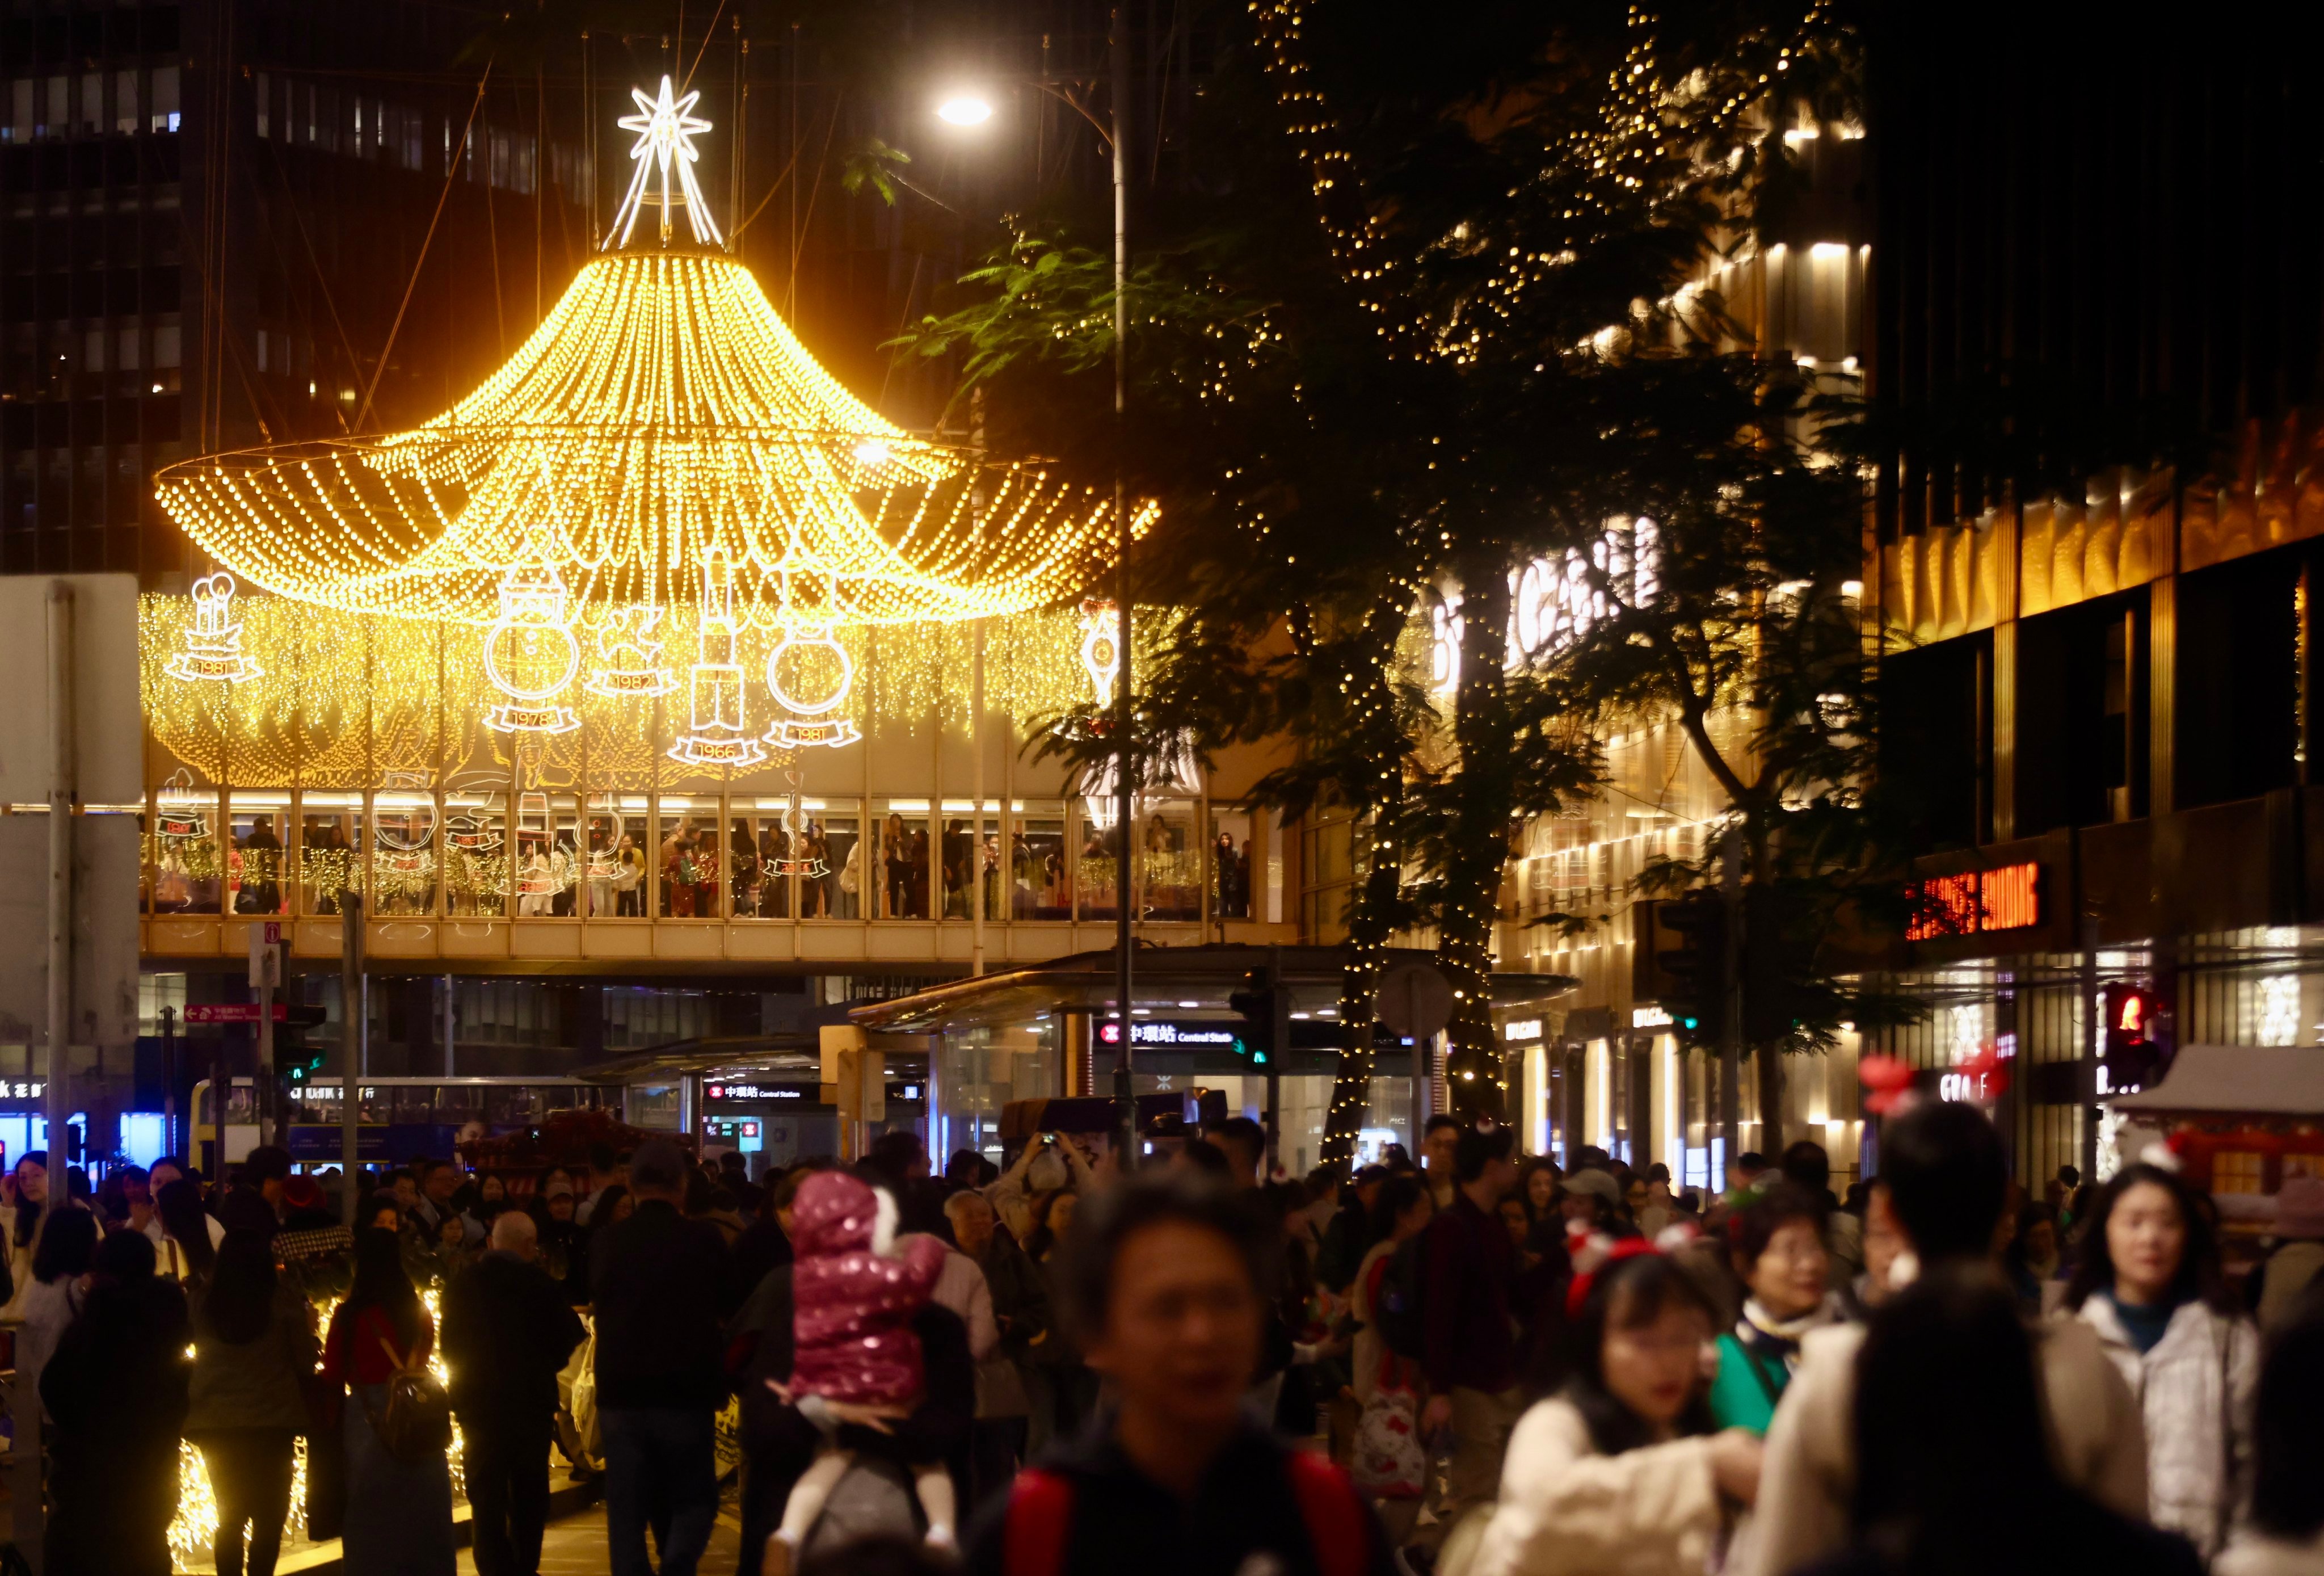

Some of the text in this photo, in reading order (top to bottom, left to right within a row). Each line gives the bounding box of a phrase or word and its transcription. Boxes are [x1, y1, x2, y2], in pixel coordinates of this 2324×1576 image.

[199, 661, 228, 675] 1981
[614, 675, 651, 689] 1982
[512, 713, 549, 726] 1978
[796, 728, 825, 741] 1981
[698, 745, 735, 759] 1966
[1178, 1033, 1209, 1043] Central
[725, 1086, 757, 1098] 中環站
[1940, 1072, 1989, 1103] GRAF
